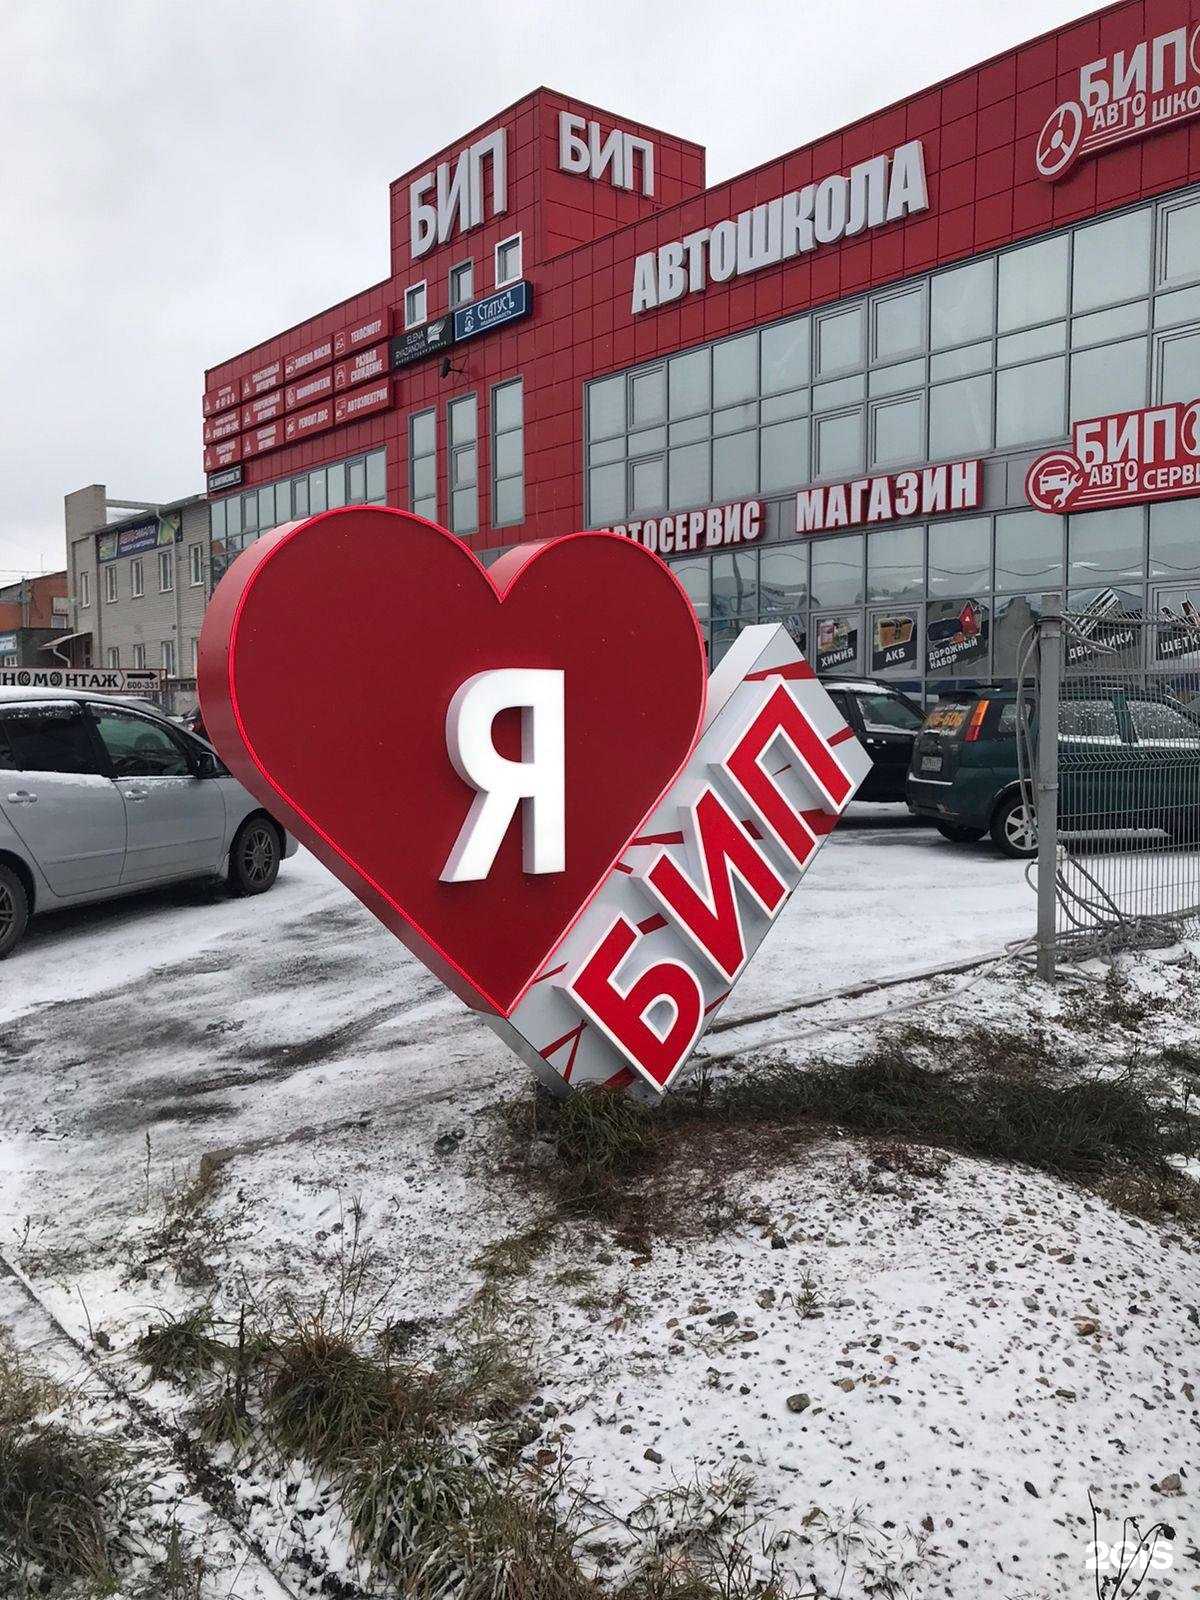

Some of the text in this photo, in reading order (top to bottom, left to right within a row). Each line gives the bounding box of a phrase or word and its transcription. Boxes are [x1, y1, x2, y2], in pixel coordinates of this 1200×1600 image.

[1080, 26, 1187, 127] БИП
[1093, 91, 1146, 131] АВТО
[559, 110, 655, 197] БИП
[409, 127, 507, 260] БИП
[631, 140, 929, 315] АВТОШКОЛА
[1077, 407, 1177, 492] БИП
[1088, 458, 1138, 488] АВТО
[600, 501, 763, 553] ТОСЕРВИС
[796, 461, 978, 532] МАГАЗИН
[821, 648, 855, 668] ХИМИЯ
[885, 648, 906, 663] АКБ
[928, 637, 979, 661] ДОРОЖНЫЙ
[930, 653, 958, 669] НАБОР
[438, 667, 566, 883] Я
[555, 677, 856, 1094] БИП
